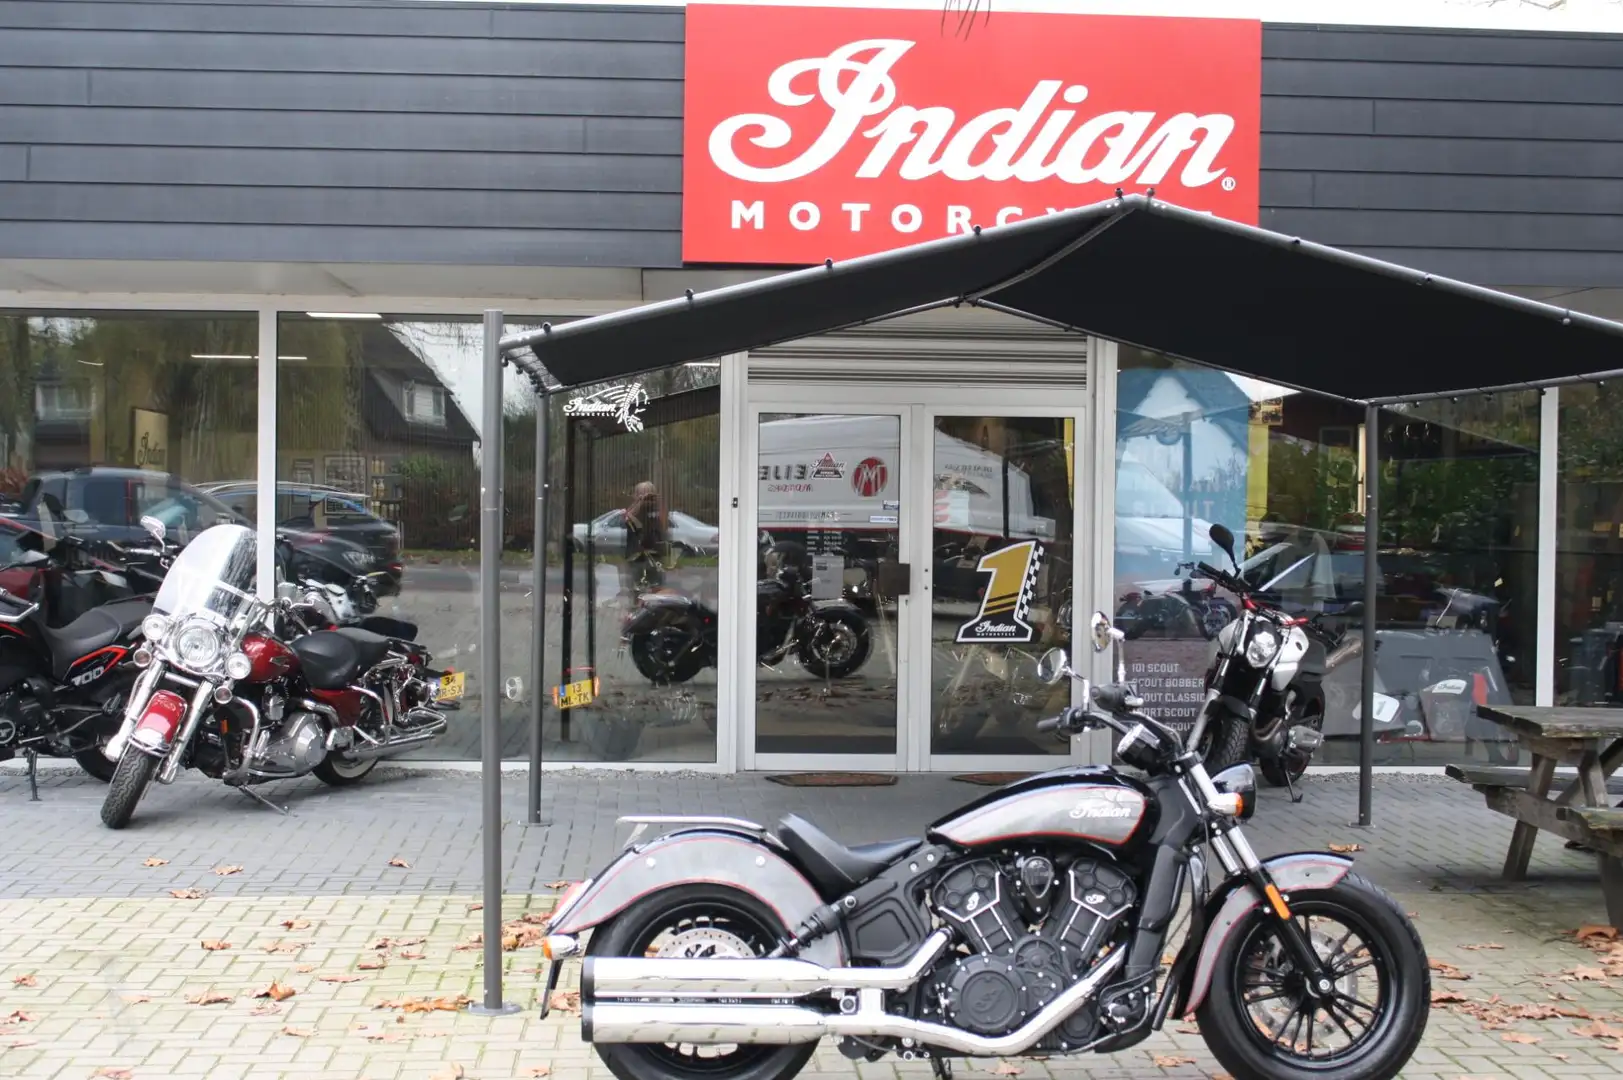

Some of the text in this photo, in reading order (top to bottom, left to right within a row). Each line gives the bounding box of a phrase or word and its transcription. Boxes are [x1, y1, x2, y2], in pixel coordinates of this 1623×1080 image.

[708, 39, 1235, 187] Indian
[731, 200, 1212, 234] MOTORC
[563, 397, 616, 412] Indian
[975, 620, 1017, 632] Indian
[1147, 663, 1179, 672] SCOUT
[71, 666, 104, 686] 700
[1165, 678, 1204, 687] BOBBER
[1165, 693, 1205, 702] CLASSIC
[1165, 708, 1196, 717] SCOUT
[1069, 800, 1131, 818] Indian
